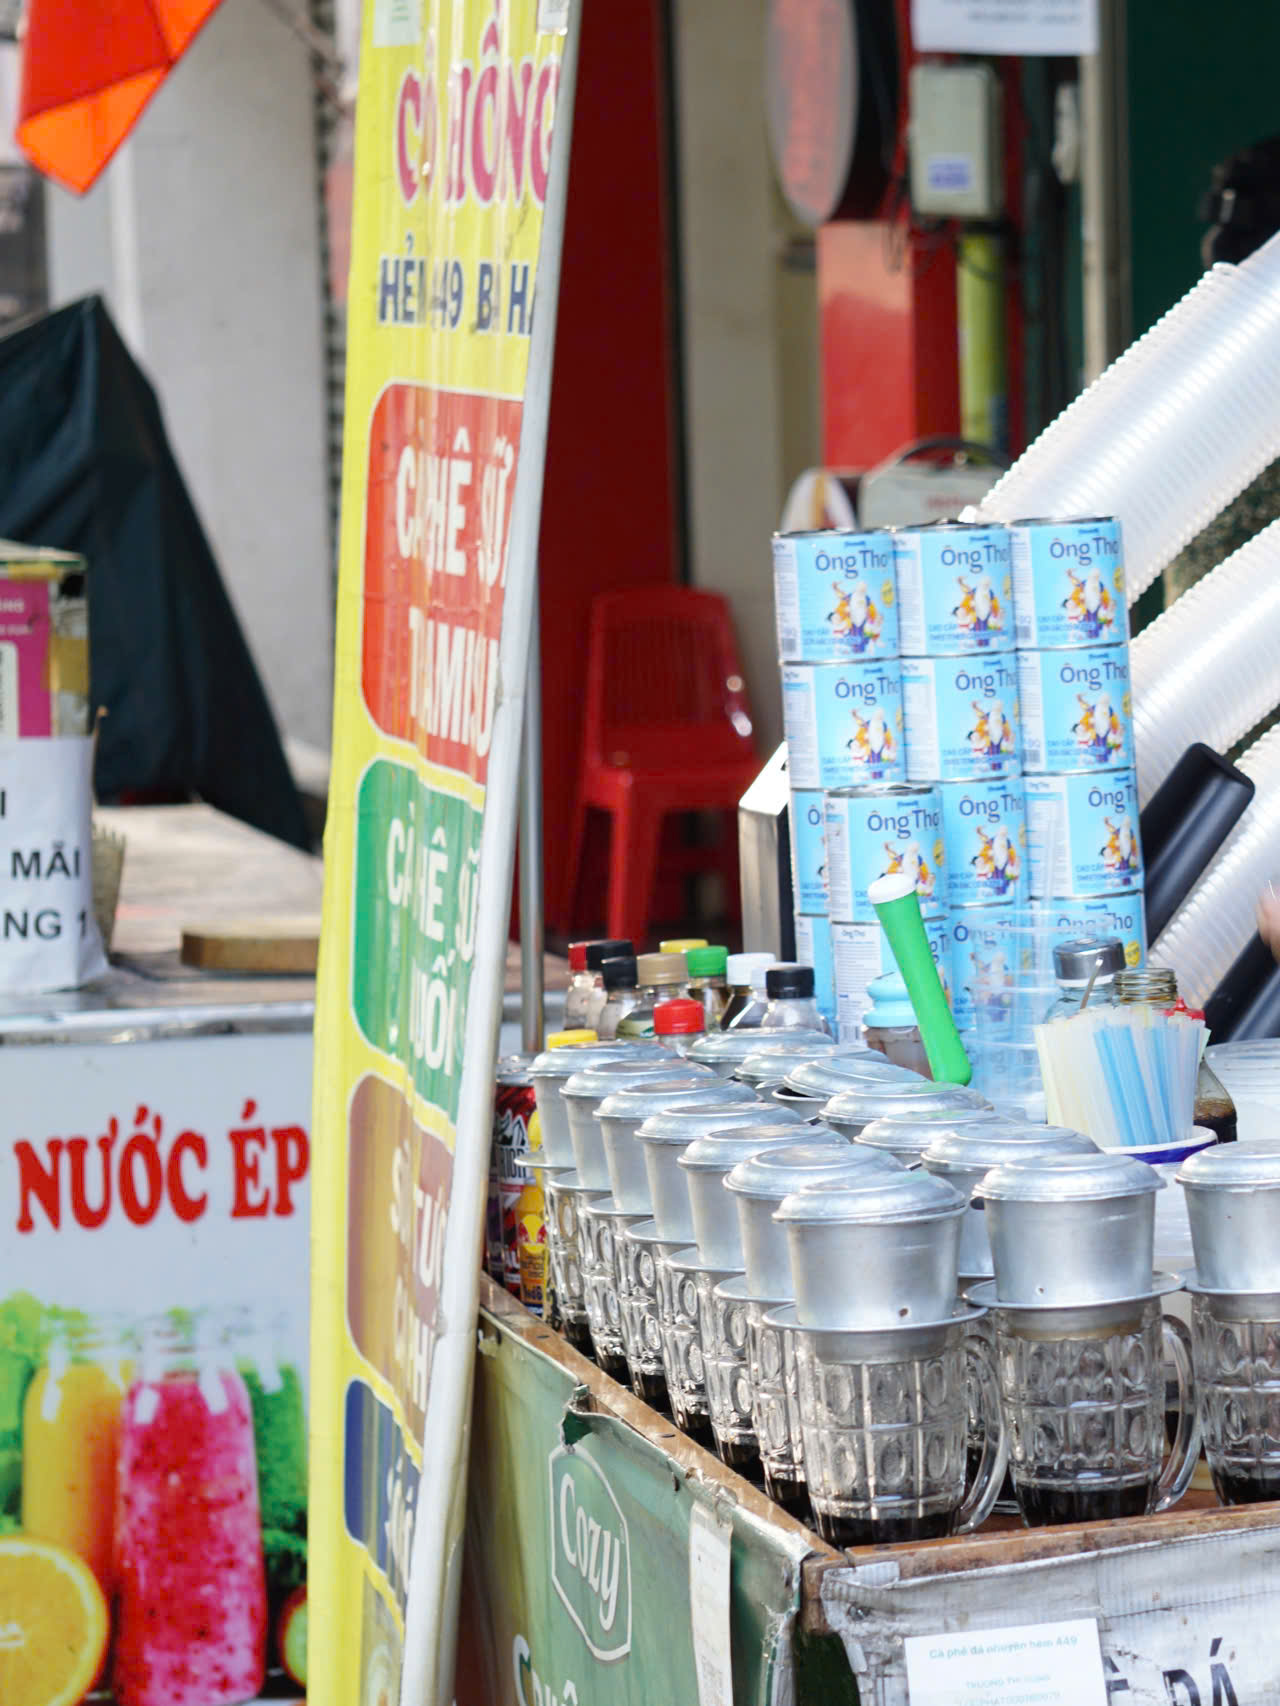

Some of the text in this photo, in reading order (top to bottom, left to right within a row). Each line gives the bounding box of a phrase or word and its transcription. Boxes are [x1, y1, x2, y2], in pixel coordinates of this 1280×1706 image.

[815, 550, 858, 579] Ông
[941, 546, 983, 574] Ông
[1049, 538, 1092, 566] Ông
[955, 670, 997, 698] Ông
[1060, 663, 1103, 690] Ông
[835, 677, 876, 706] Ông
[959, 795, 1001, 823] Ông
[1088, 786, 1125, 814] Ông
[867, 810, 912, 839] Ông
[13, 1104, 208, 1233] NƯỚC
[228, 1099, 310, 1219] ÉP
[560, 1473, 620, 1631] Cozy
